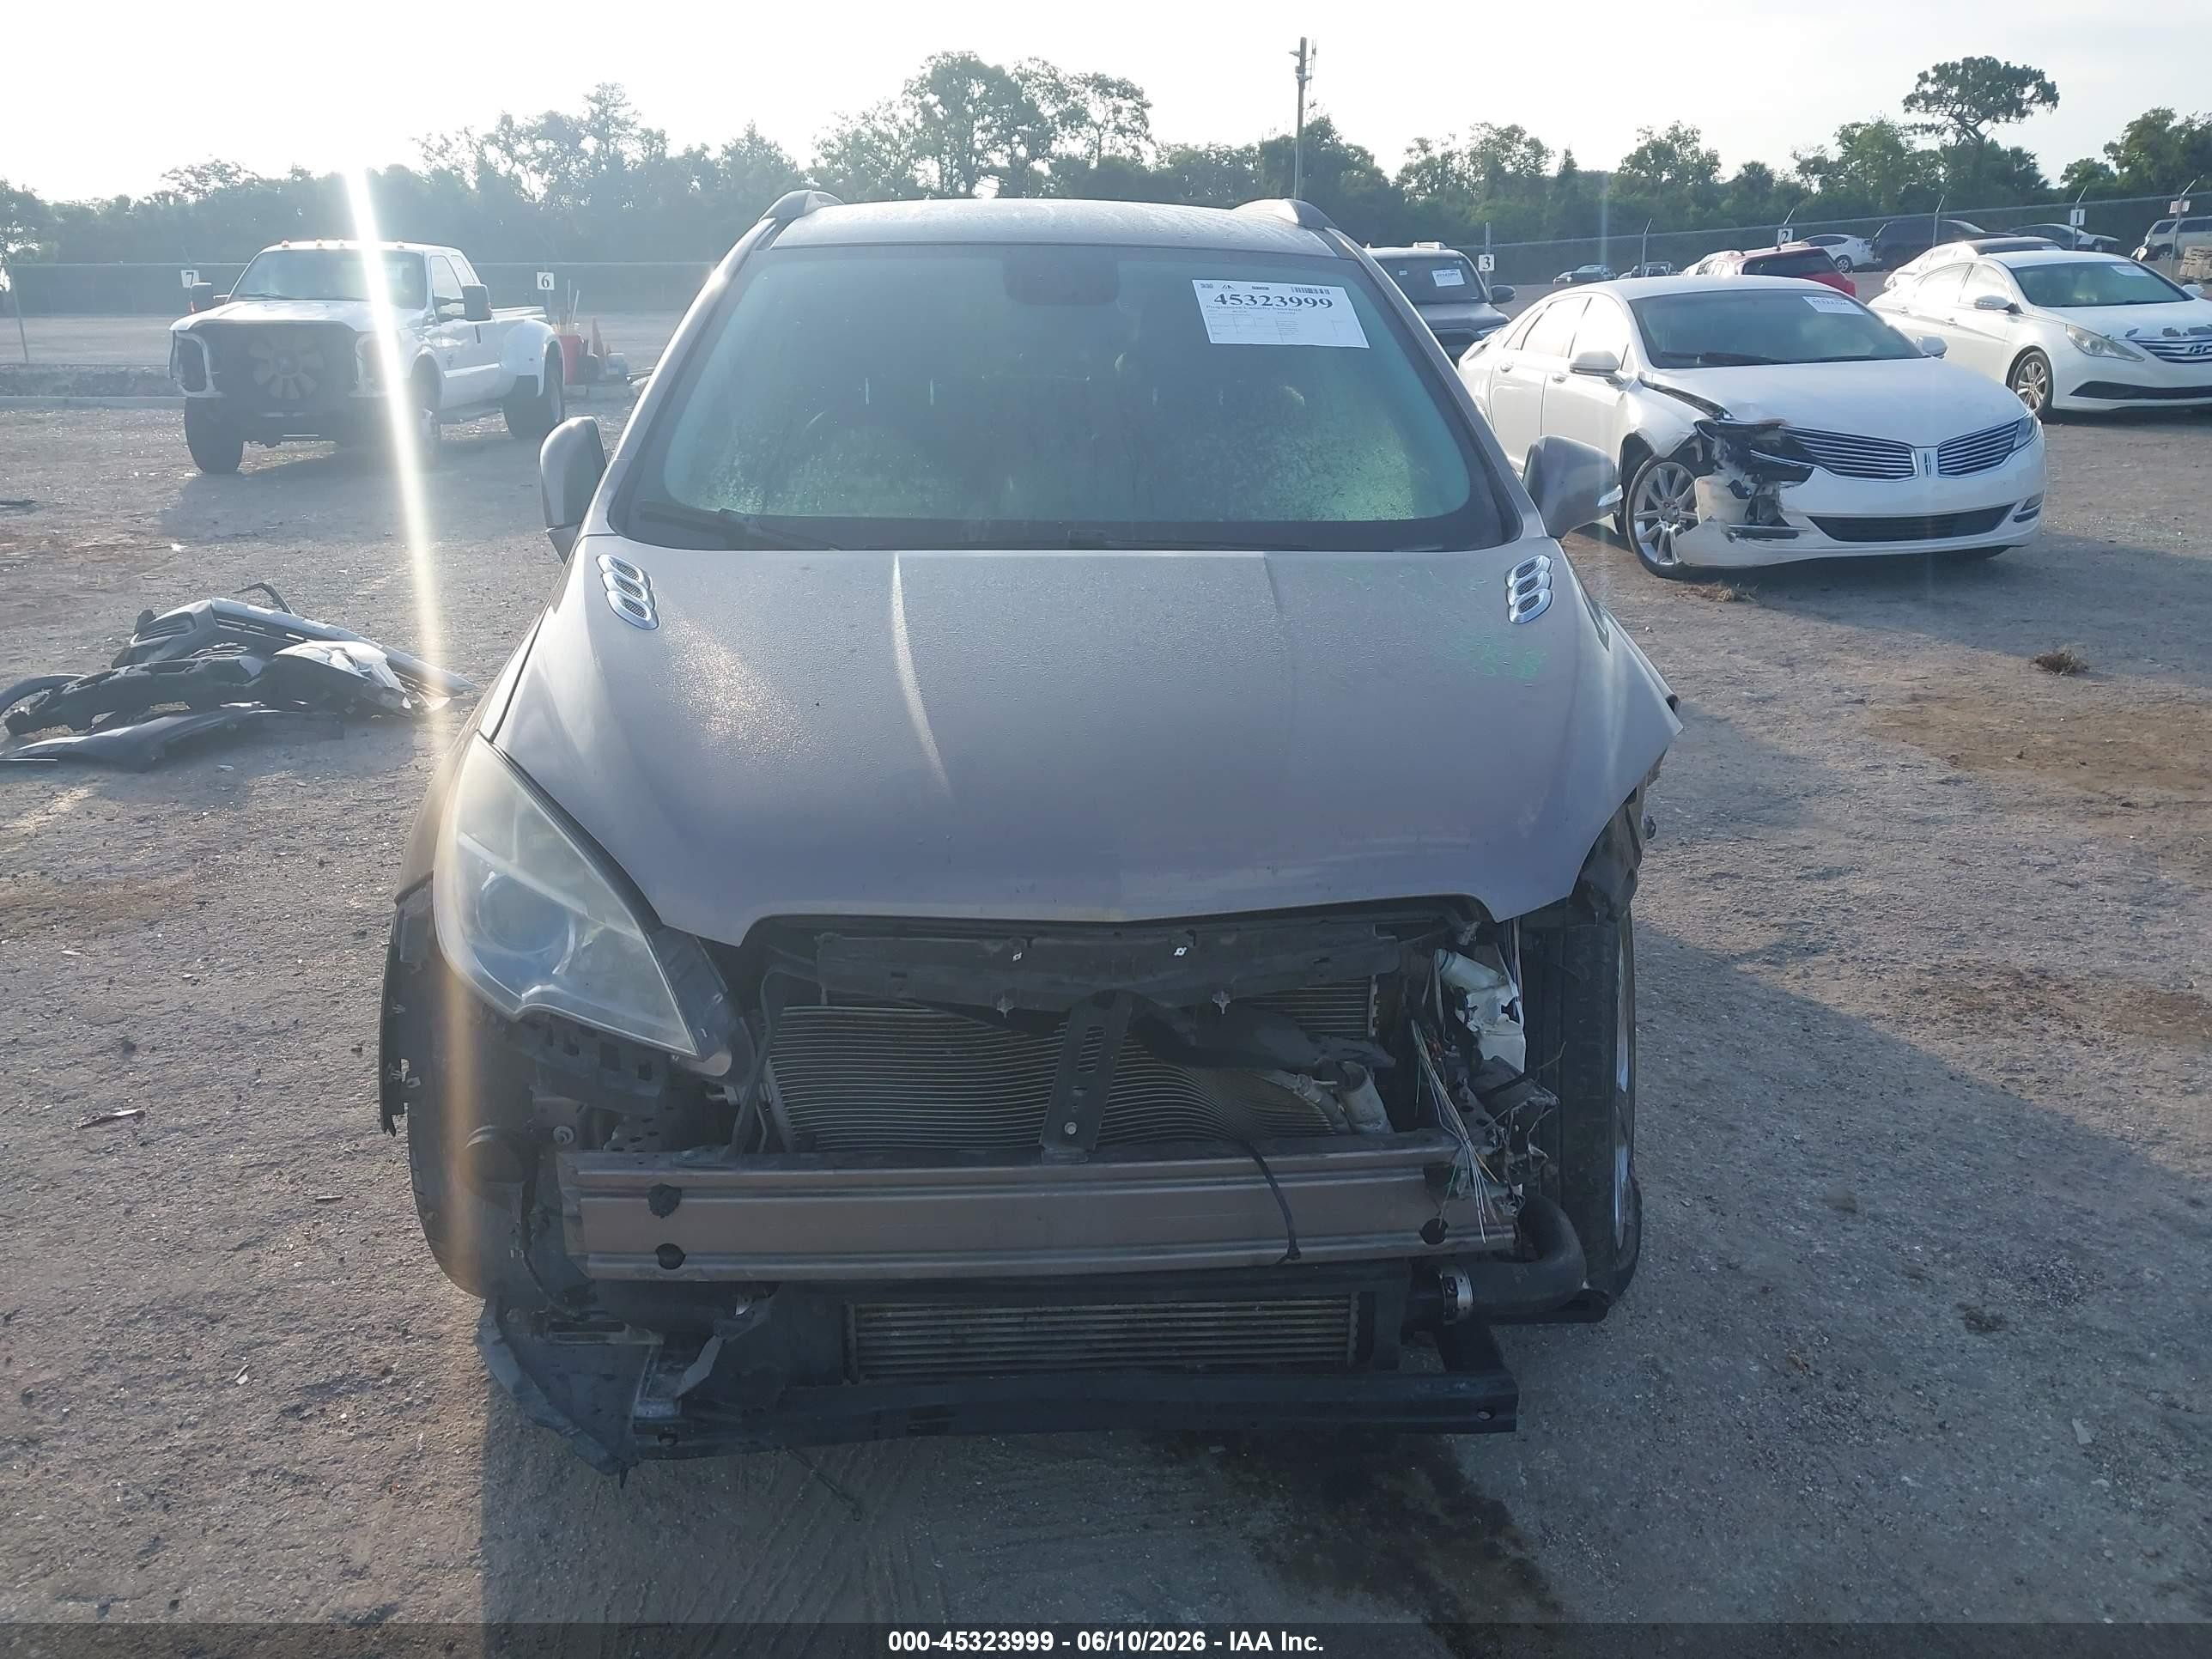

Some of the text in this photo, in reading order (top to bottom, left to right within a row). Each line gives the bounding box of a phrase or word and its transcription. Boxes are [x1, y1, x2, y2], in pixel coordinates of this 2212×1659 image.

[1781, 230, 1789, 244] 2
[1482, 256, 1491, 270] 3
[185, 271, 195, 288] 7
[541, 274, 550, 289] 6
[1213, 293, 1334, 309] 45323999
